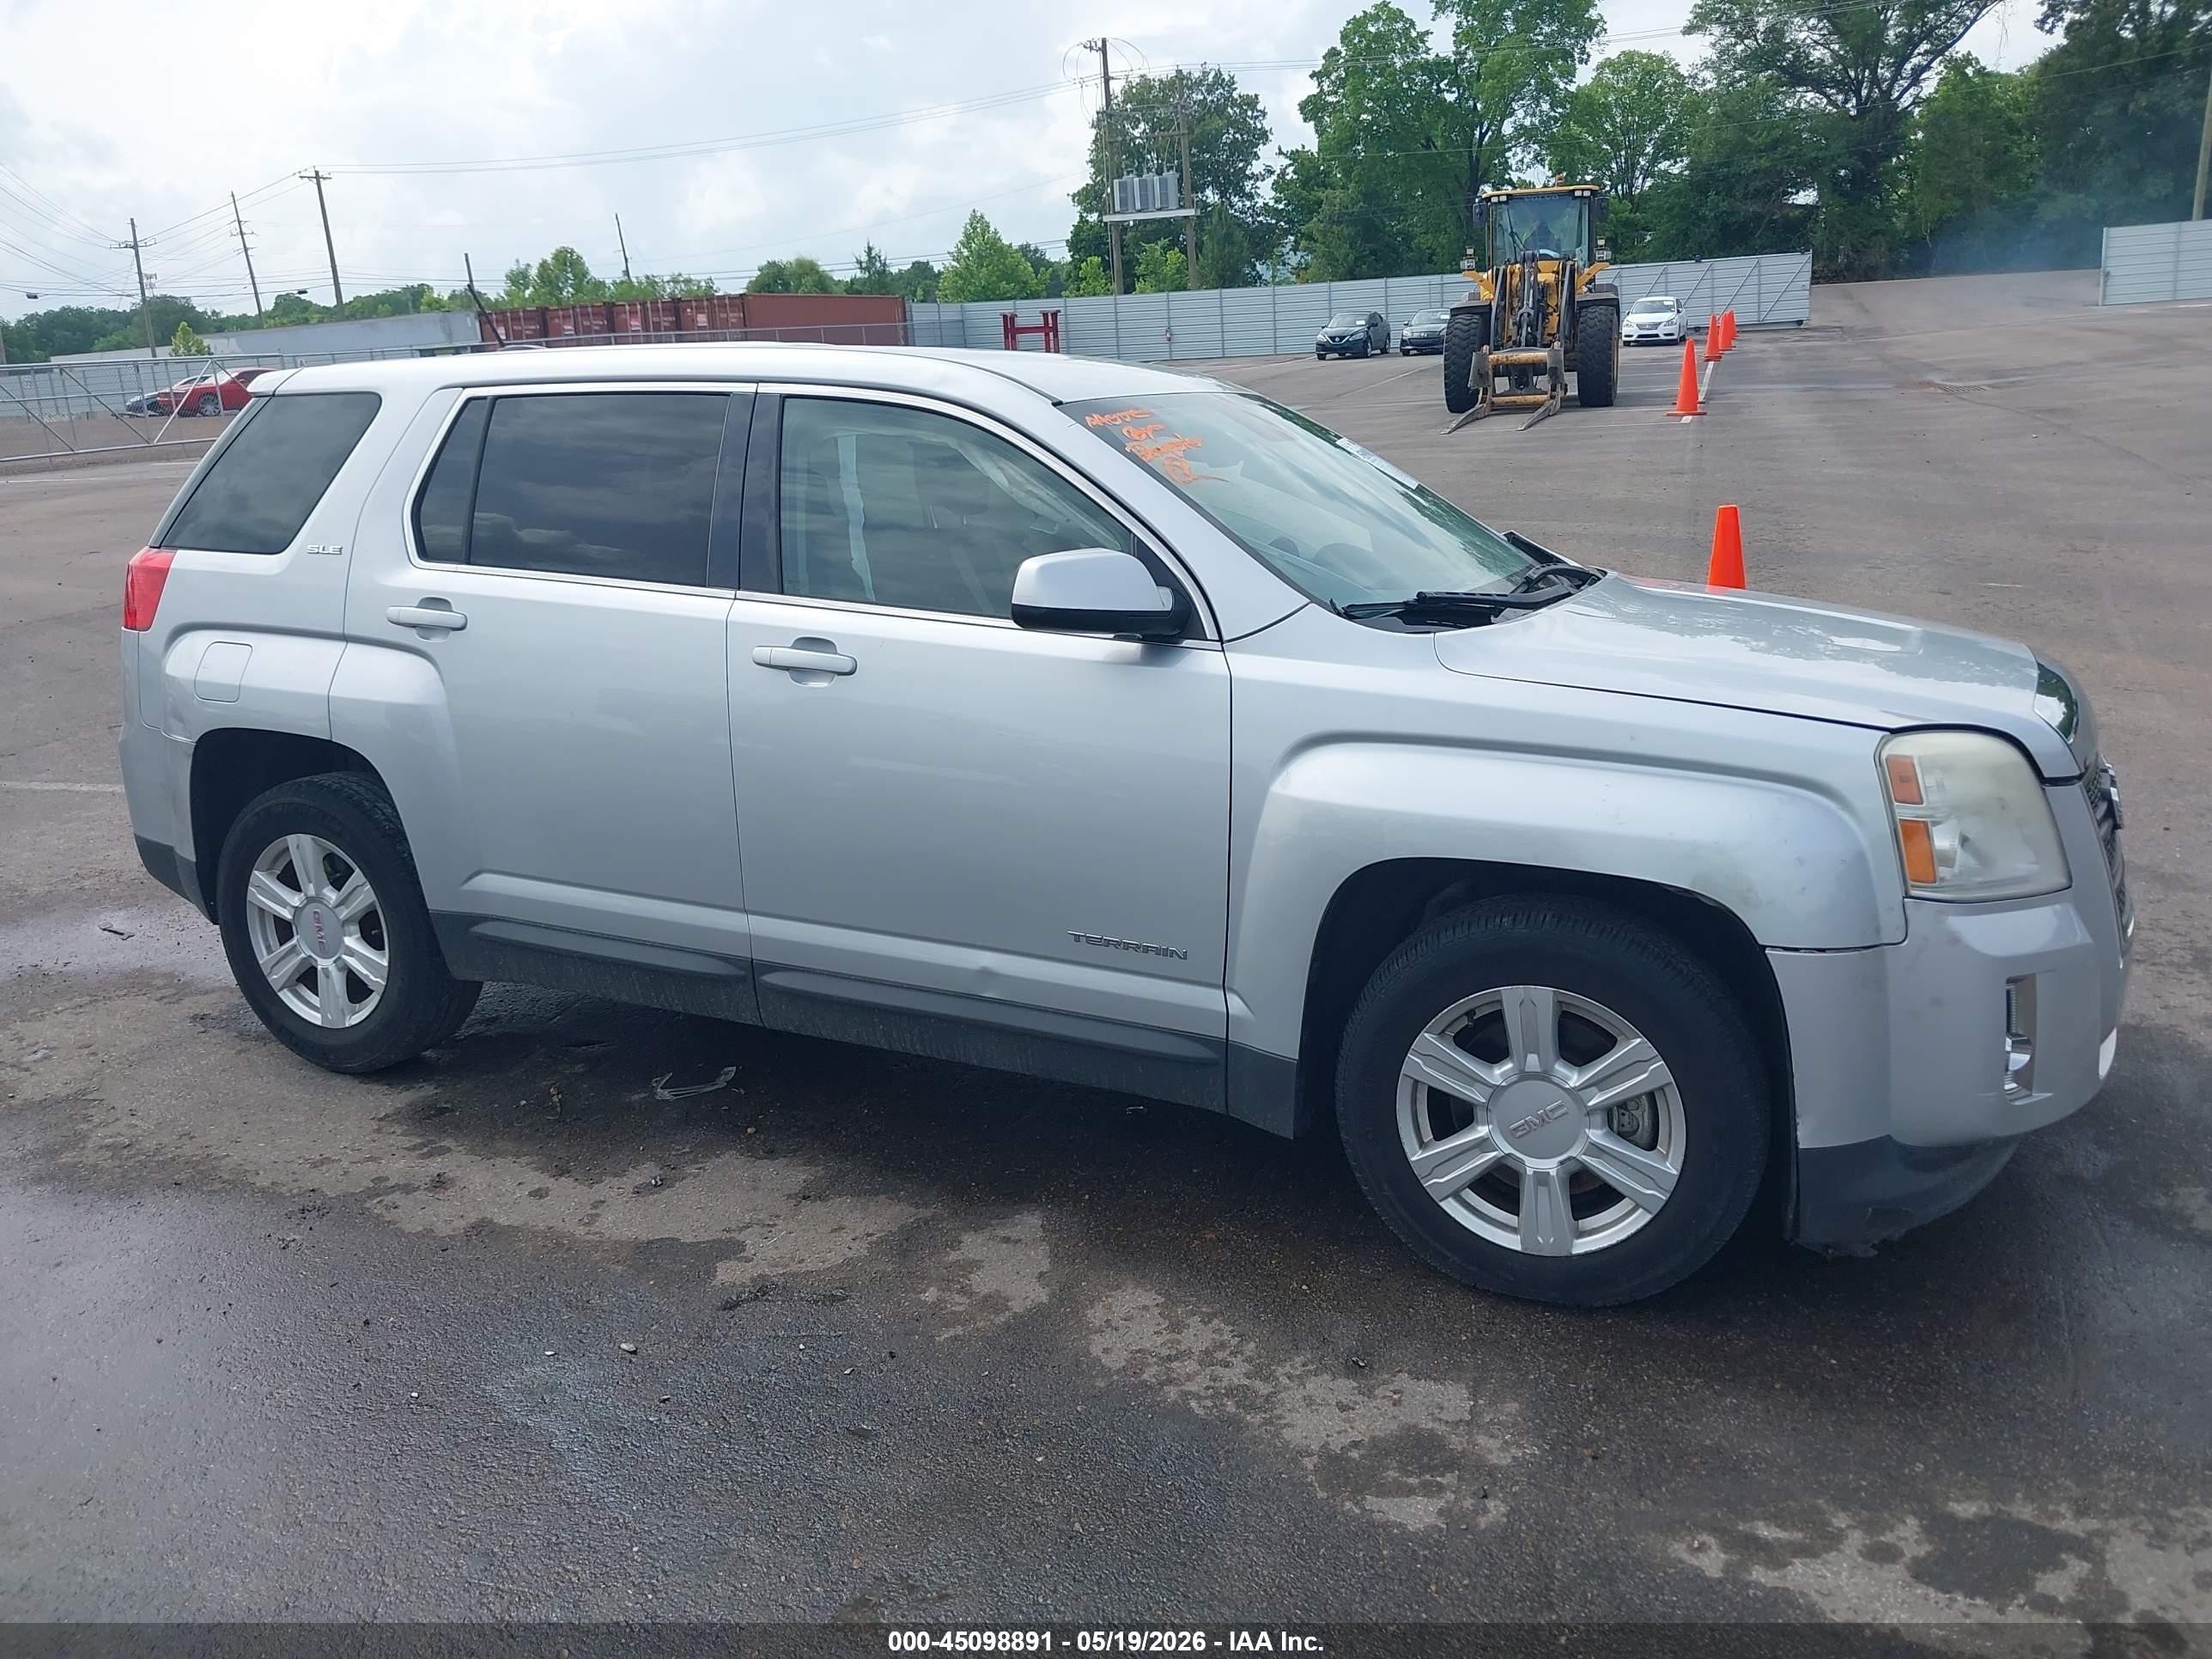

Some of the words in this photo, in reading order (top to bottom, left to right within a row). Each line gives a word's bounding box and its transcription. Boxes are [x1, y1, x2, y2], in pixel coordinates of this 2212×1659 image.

[307, 544, 342, 555] SLE
[1067, 930, 1188, 960] TERRAIN
[1510, 1100, 1568, 1139] GMC
